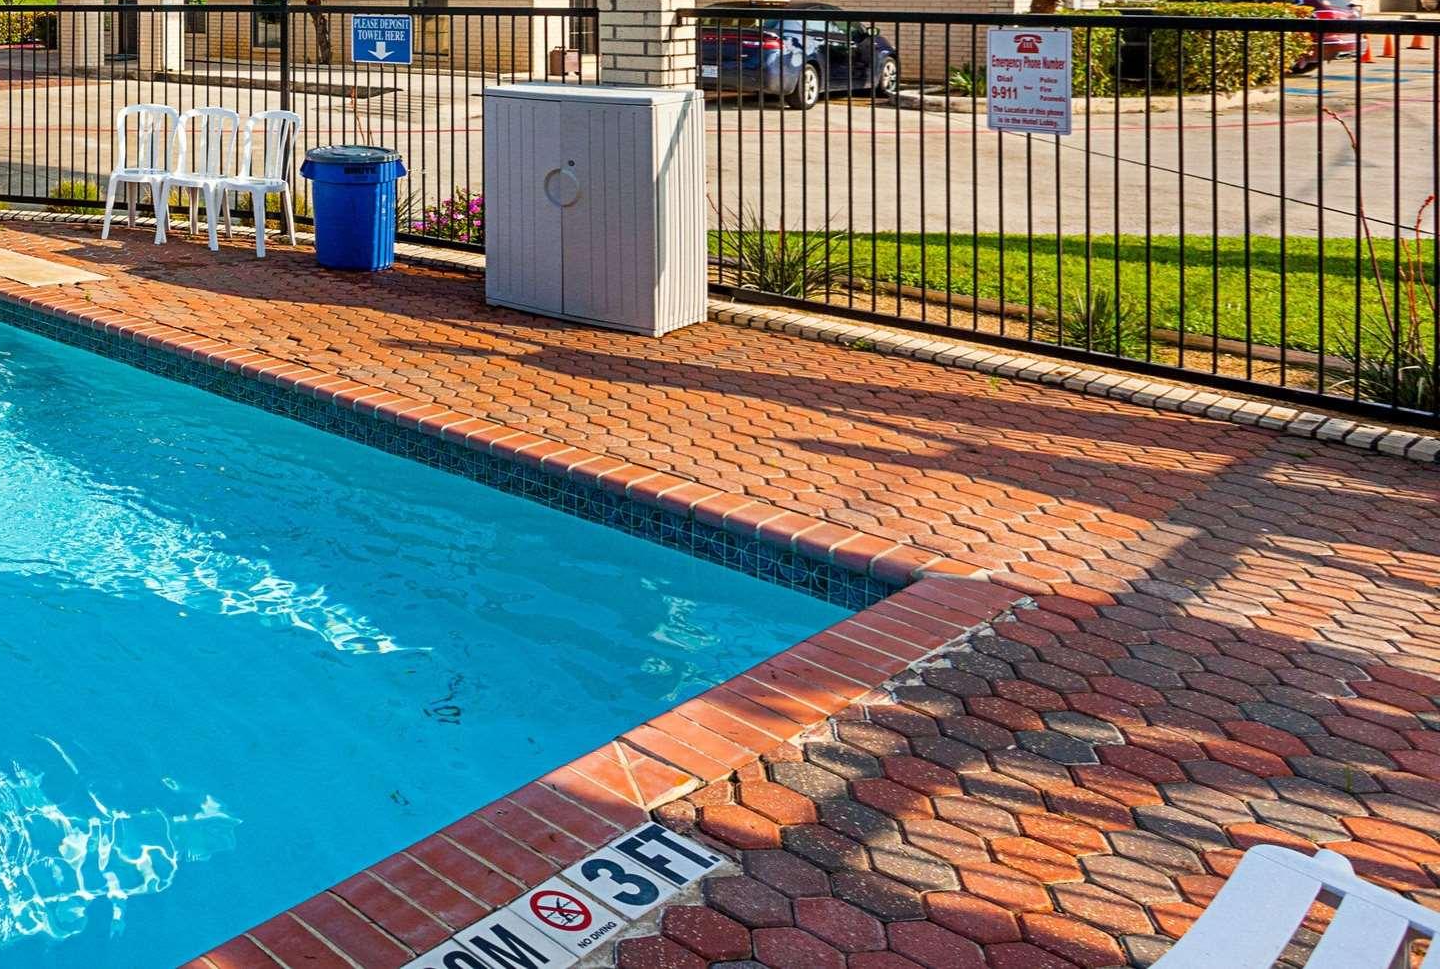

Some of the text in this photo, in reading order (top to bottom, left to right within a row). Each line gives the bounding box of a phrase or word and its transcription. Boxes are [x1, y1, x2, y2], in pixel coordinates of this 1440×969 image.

[353, 18, 409, 30] PLEASE DEPOSIT
[357, 29, 406, 41] TOWEL HERE
[992, 54, 1065, 72] Emergency Phone Number
[992, 86, 1018, 99] 9-911
[1004, 106, 1027, 114] Location
[1022, 118, 1038, 126] Hotel
[577, 921, 618, 949] NO DIVING
